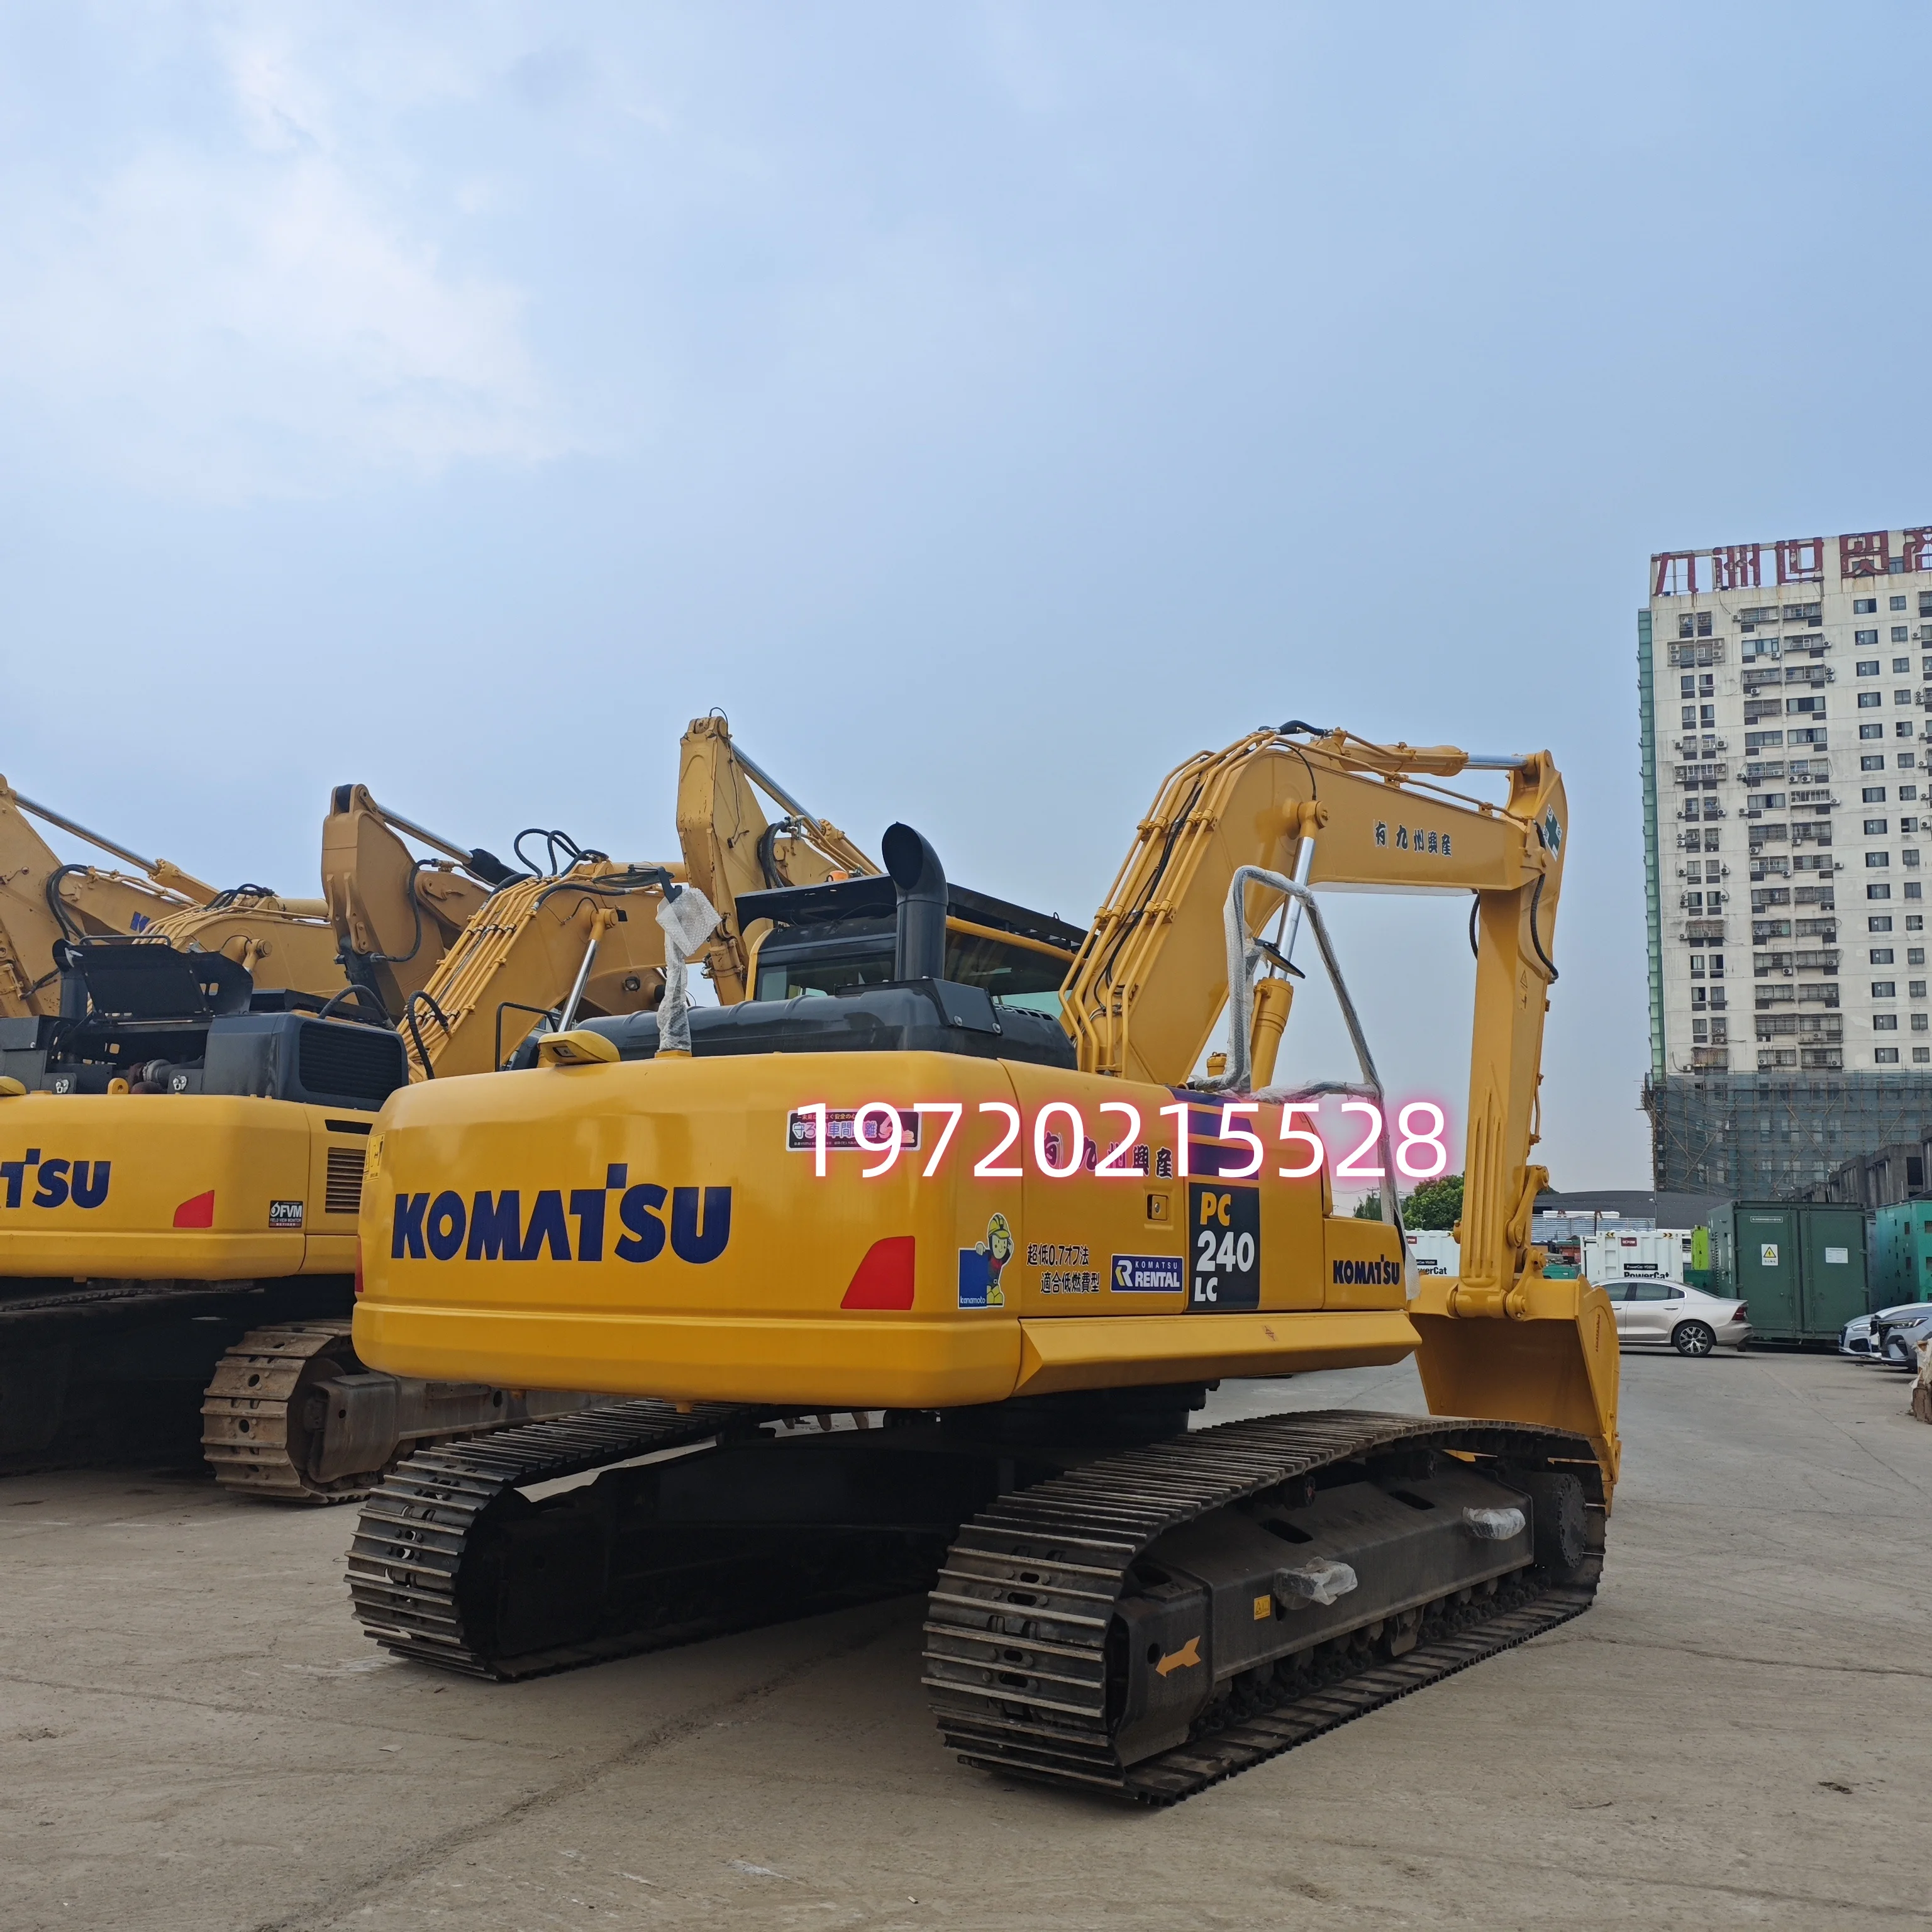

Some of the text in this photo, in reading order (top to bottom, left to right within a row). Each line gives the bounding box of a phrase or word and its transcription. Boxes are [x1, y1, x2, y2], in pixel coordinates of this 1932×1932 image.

[793, 1121, 877, 1138] 守ろ車間離
[0, 1148, 111, 1208] TSU
[280, 1205, 302, 1218] FVM
[391, 1163, 731, 1263] KOMATSU
[1200, 1192, 1231, 1226] PC
[1196, 1231, 1255, 1272] 240
[1135, 1261, 1177, 1269] KOMATSU
[1333, 1254, 1400, 1285] KOMATSU
[1041, 1271, 1100, 1293] 適合低燃費型
[1135, 1271, 1180, 1287] RENTAL
[1194, 1277, 1218, 1302] LC
[960, 1296, 985, 1304] kanamoto
